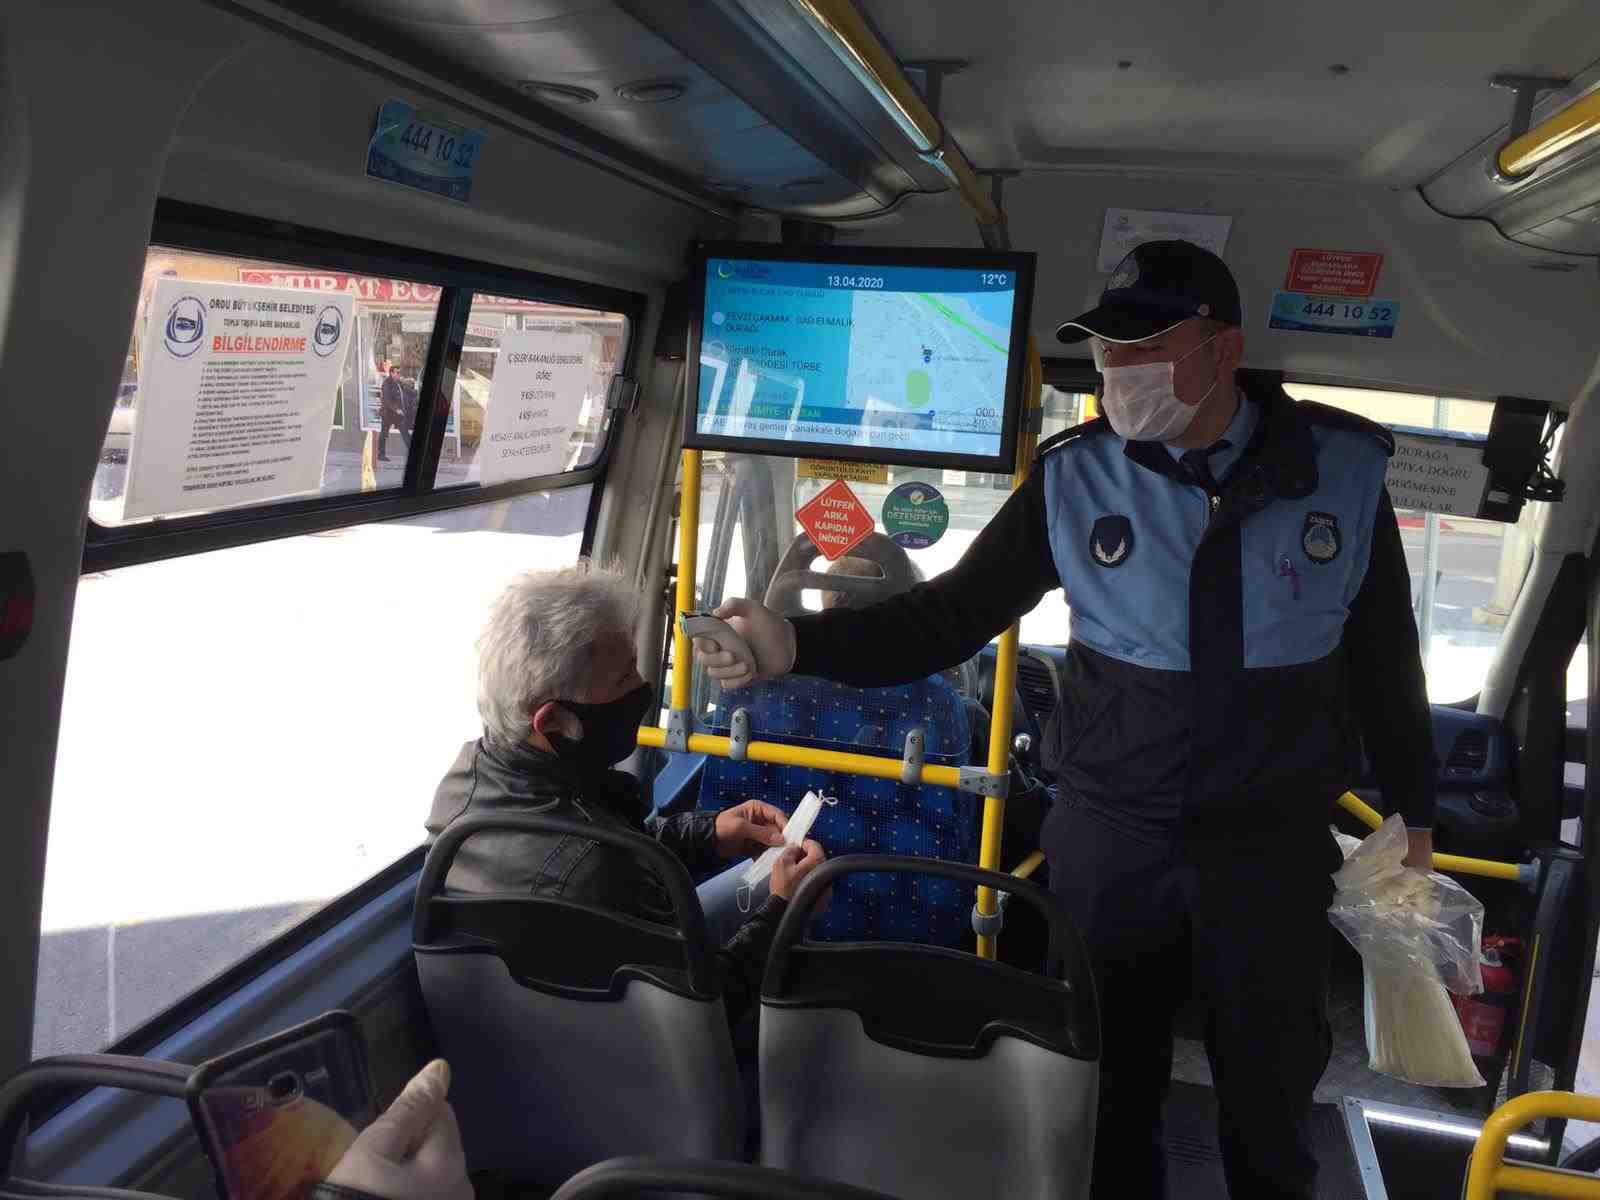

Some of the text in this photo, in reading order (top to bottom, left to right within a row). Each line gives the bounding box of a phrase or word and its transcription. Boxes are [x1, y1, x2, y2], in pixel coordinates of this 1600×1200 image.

[827, 273, 1007, 288] 13.04.2020 12°C
[209, 298, 231, 310] ORDU
[1302, 302, 1392, 321] 444 10 52
[212, 332, 307, 352] BİLGİLENDİRME
[820, 496, 855, 512] LÜTFEN
[823, 510, 848, 521] ARKA
[814, 520, 855, 536] KAPIDAN
